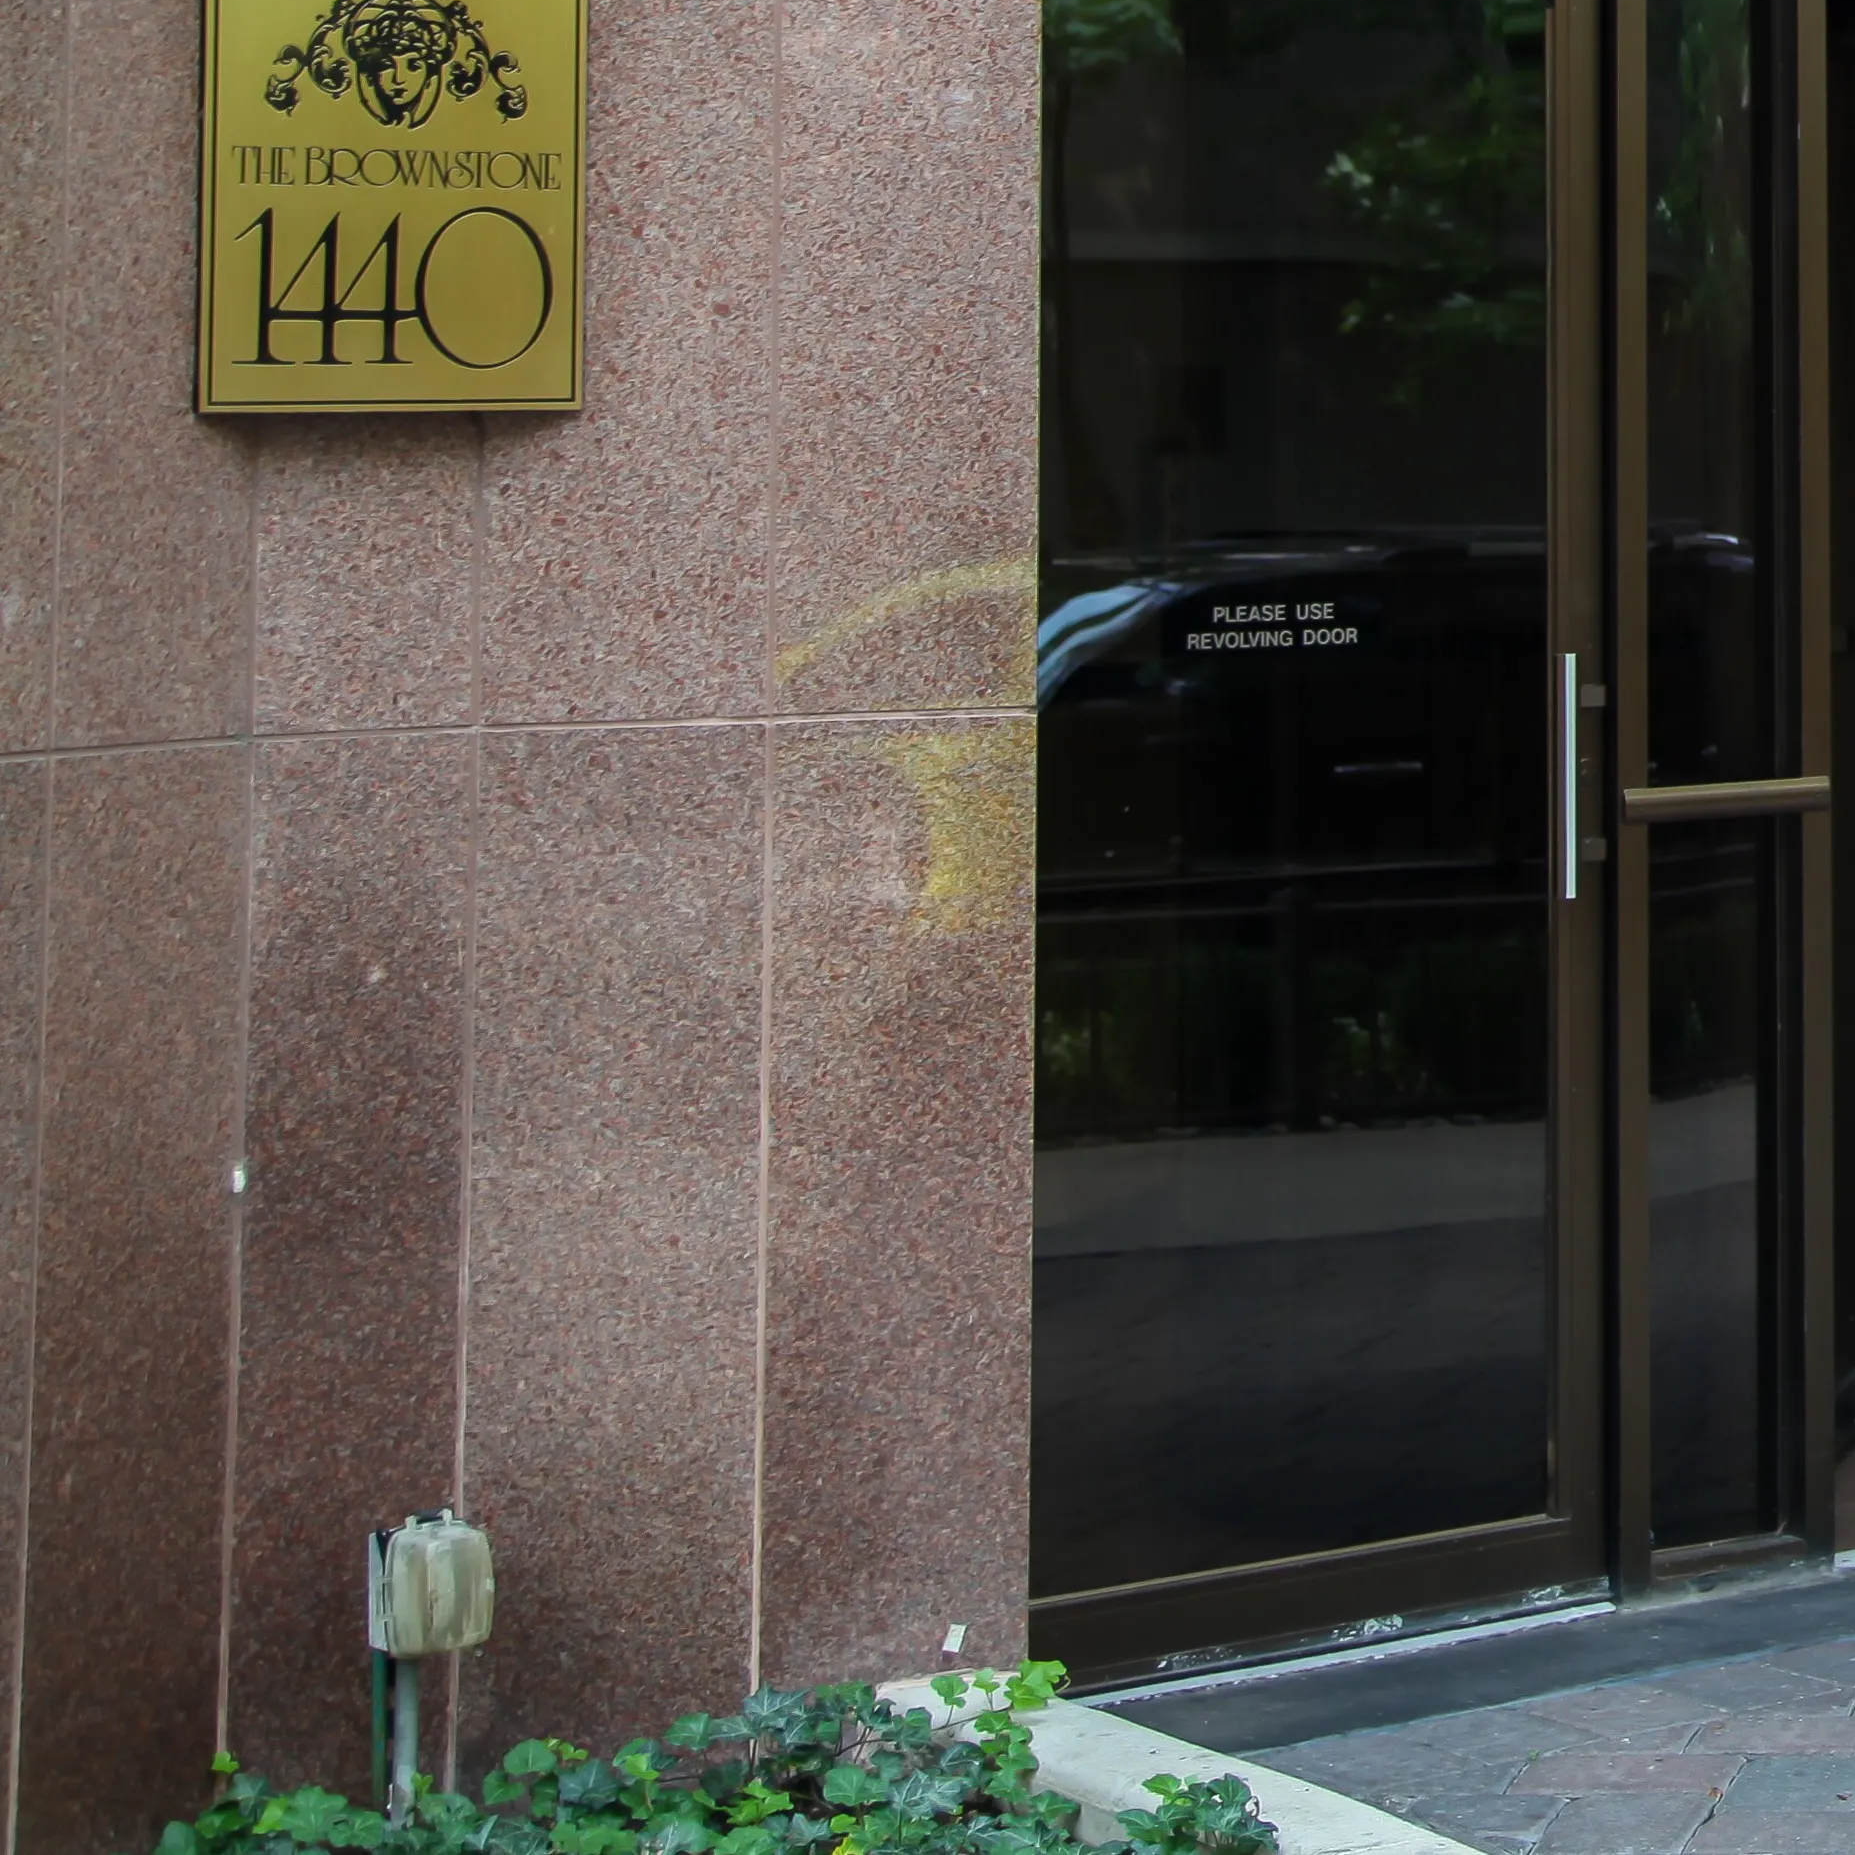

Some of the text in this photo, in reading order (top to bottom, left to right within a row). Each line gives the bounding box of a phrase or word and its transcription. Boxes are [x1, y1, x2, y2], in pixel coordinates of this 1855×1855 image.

[231, 146, 562, 191] THE BROWNSTONE
[231, 206, 553, 369] 1440
[1212, 602, 1335, 623] PLEASE USE
[1186, 627, 1358, 650] REVOLVING DOOR
